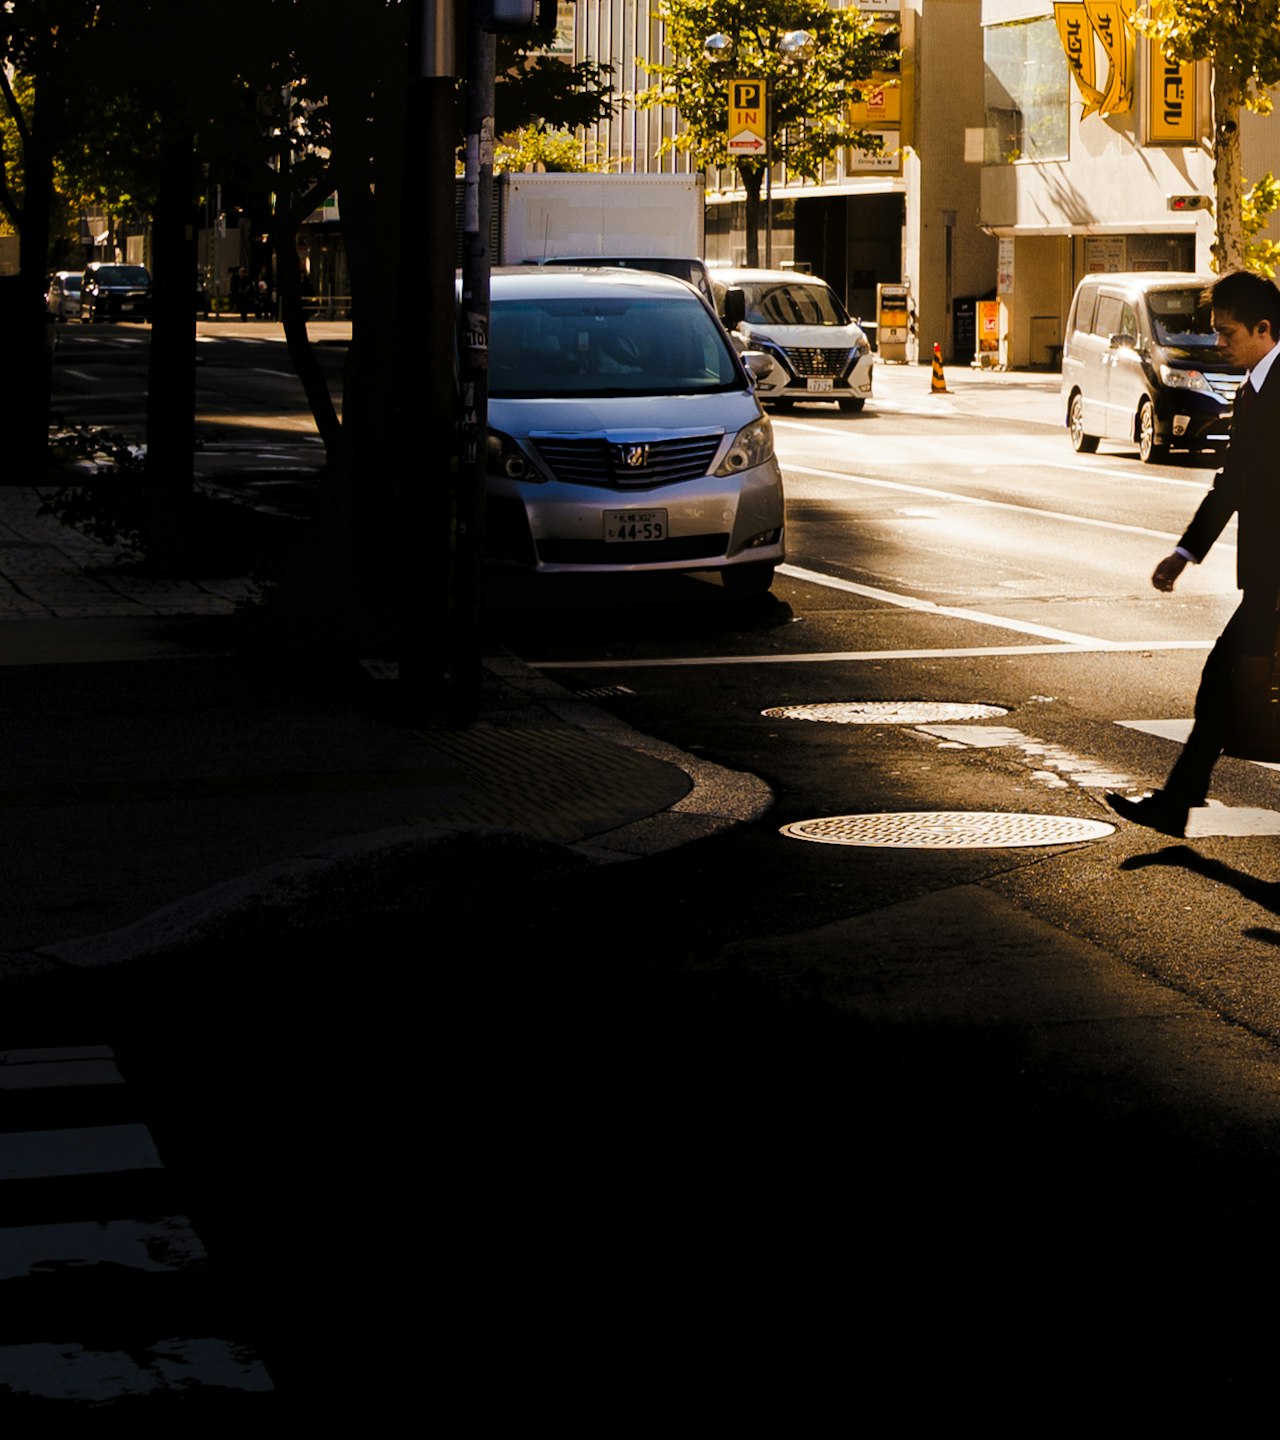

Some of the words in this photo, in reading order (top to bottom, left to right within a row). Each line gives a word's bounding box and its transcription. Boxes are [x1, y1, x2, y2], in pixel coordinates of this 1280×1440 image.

[739, 86, 756, 107] P
[737, 111, 756, 124] IN
[618, 523, 662, 540] 44-59
